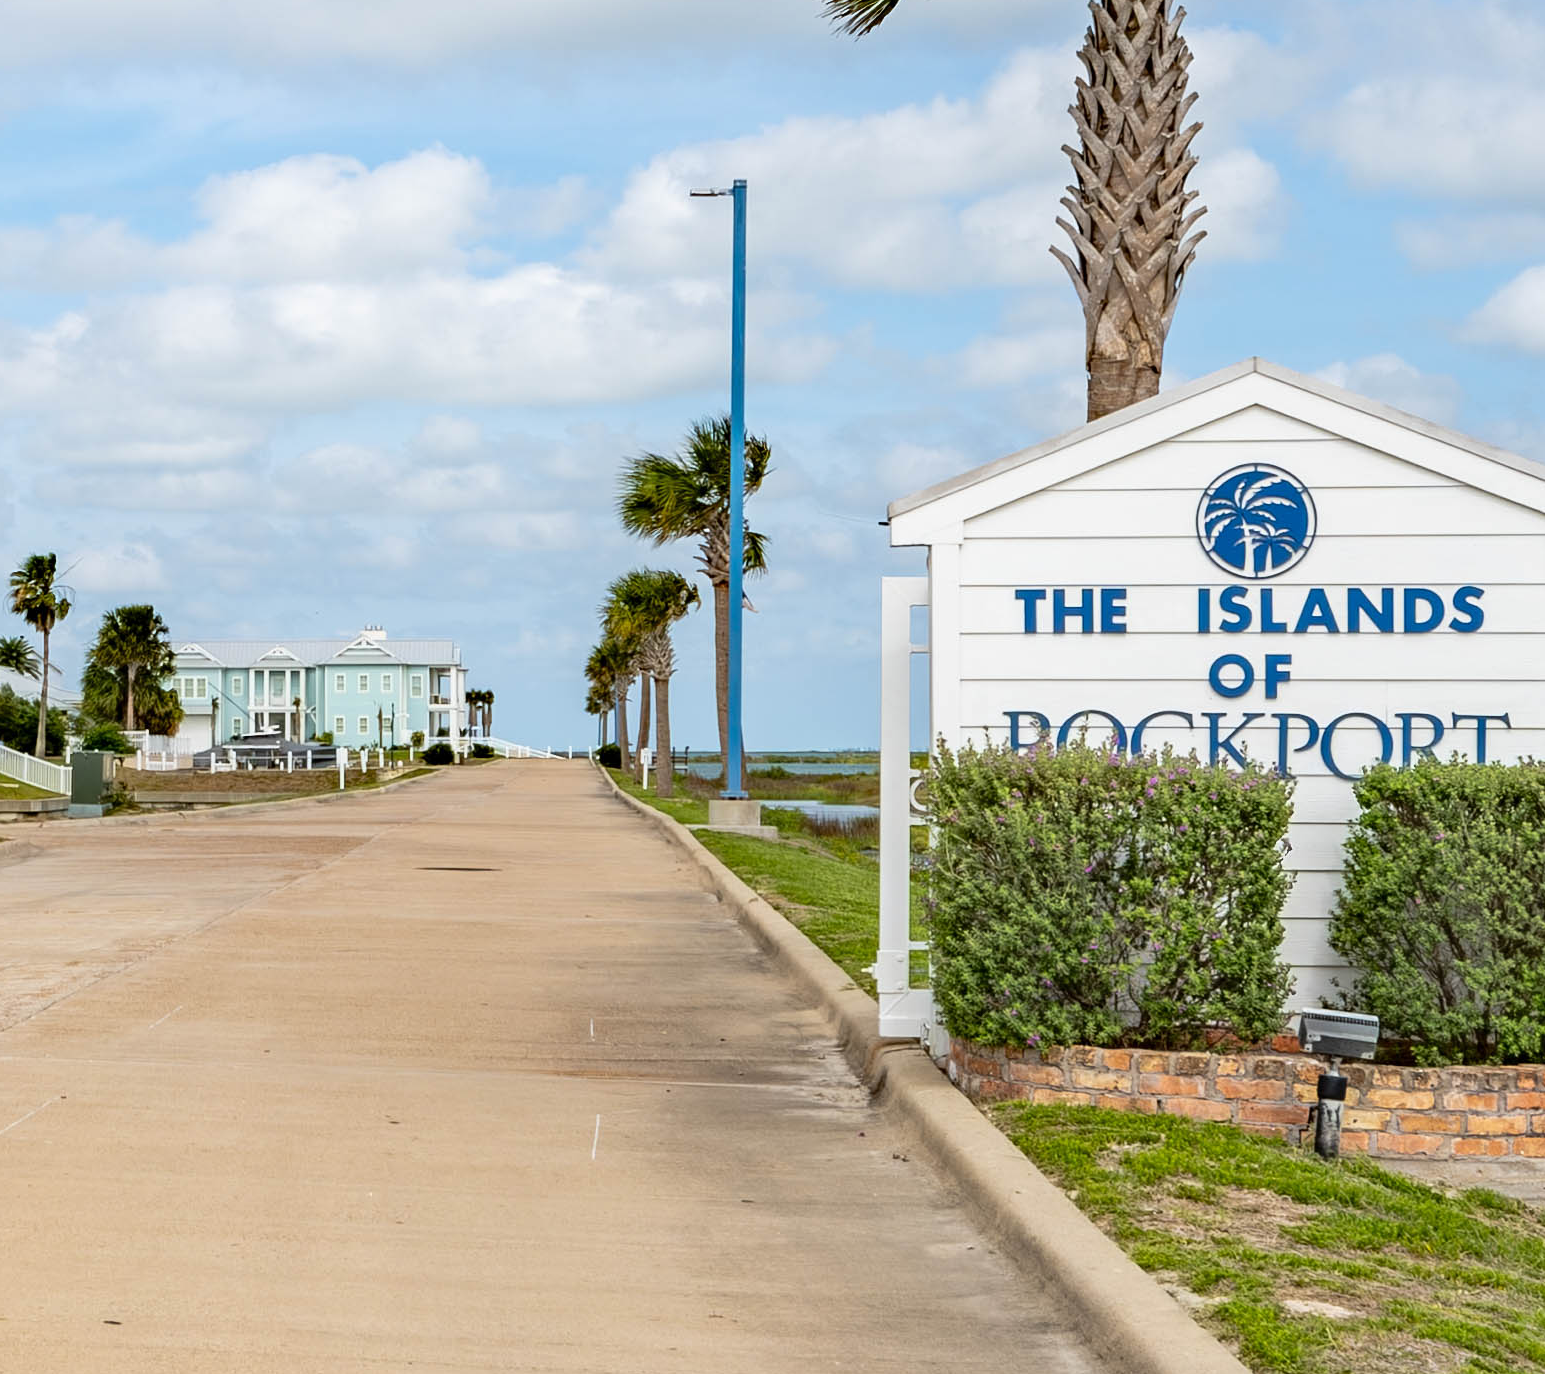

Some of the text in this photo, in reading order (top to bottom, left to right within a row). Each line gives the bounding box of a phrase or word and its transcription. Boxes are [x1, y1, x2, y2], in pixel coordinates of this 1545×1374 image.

[1014, 584, 1485, 634] THE ISLANDS
[1208, 653, 1293, 699] OF
